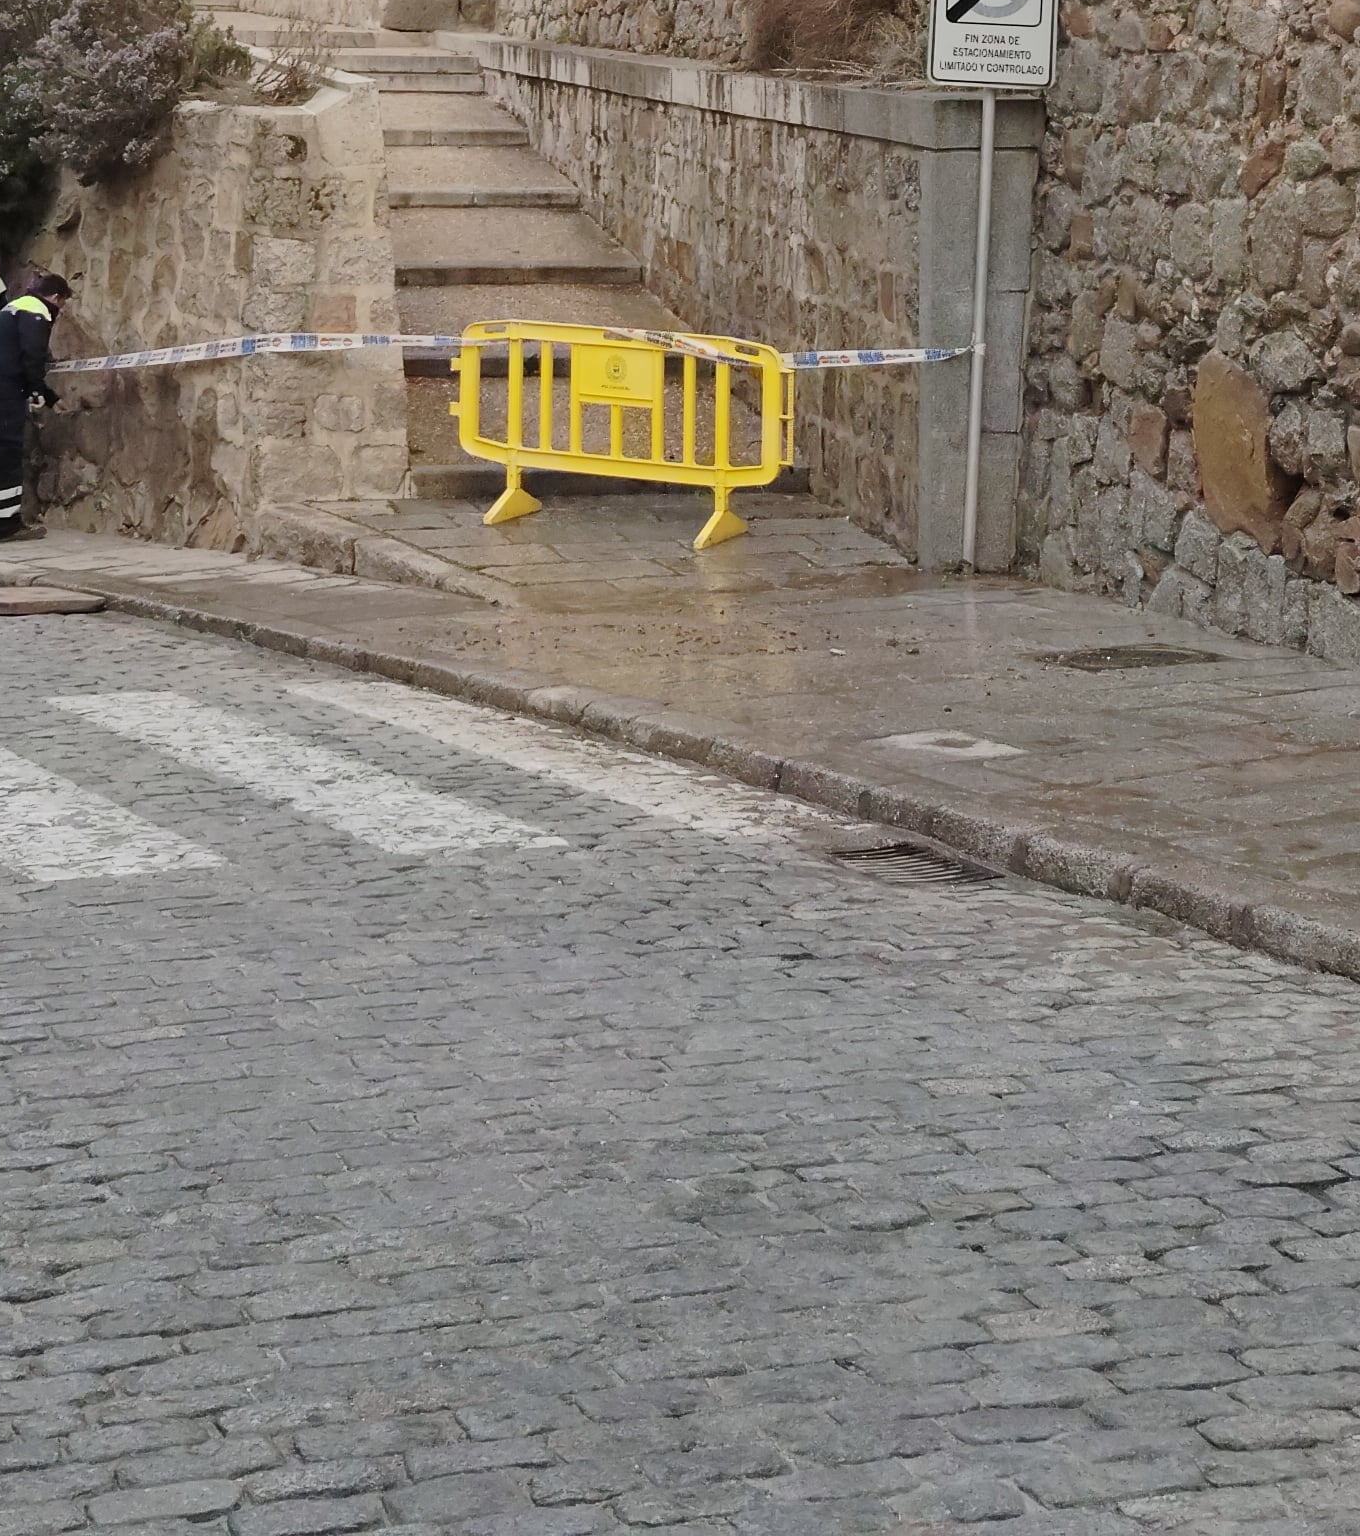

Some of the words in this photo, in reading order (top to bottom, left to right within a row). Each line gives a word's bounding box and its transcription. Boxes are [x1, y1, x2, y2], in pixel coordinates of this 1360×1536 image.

[965, 33, 979, 44] FIN
[981, 34, 1006, 45] ZONA
[1008, 35, 1020, 46] DE
[953, 47, 1031, 60] ESTACIONAMIENTO
[940, 61, 978, 72] LIMITADO
[979, 62, 985, 72] Y
[986, 63, 1044, 75] CONTROLADO
